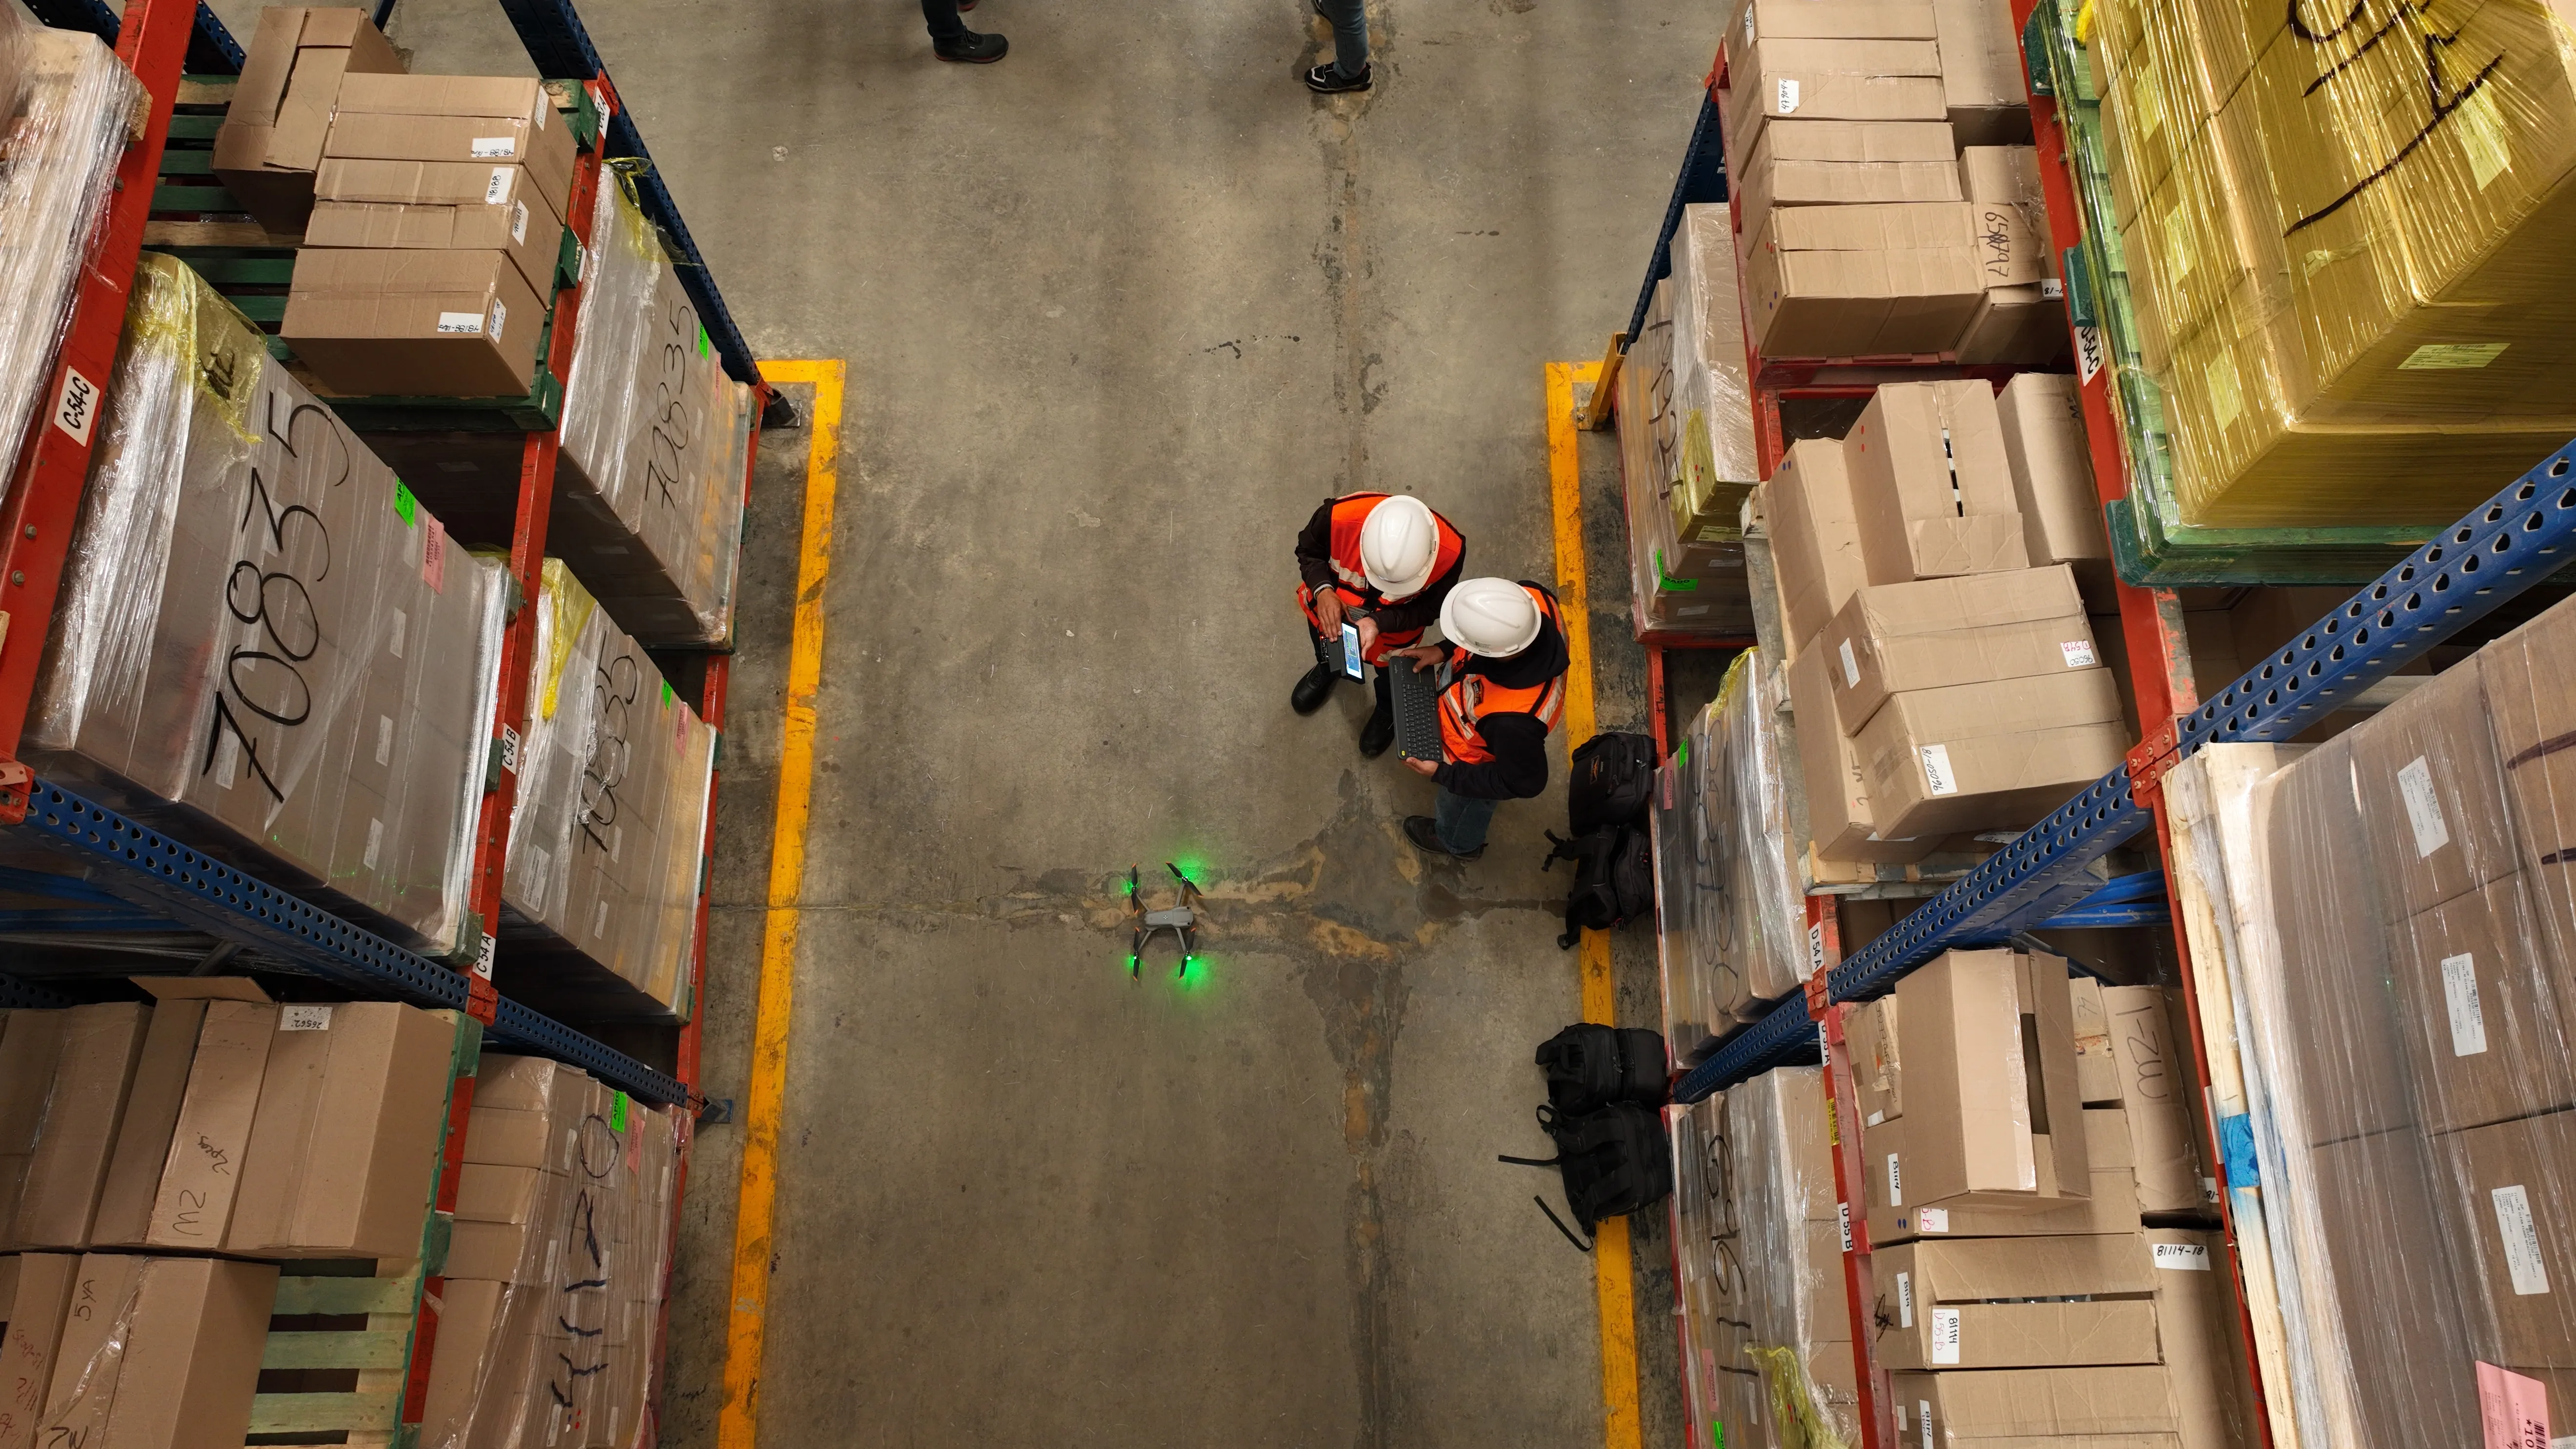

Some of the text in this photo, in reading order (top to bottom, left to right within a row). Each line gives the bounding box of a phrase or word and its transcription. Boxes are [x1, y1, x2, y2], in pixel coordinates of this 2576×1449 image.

[68, 377, 90, 429] C-54-C
[644, 299, 694, 510] 70835
[203, 391, 349, 803] 70835
[2070, 654, 2093, 665] 96050
[503, 729, 516, 766] C 54 B
[1922, 747, 1944, 791] 96050-18
[477, 962, 487, 973] C
[1811, 929, 1822, 969] D 54 A
[294, 1019, 322, 1029] 26562
[172, 1189, 206, 1236] M2
[2157, 1246, 2204, 1256] 81114-18
[74, 1303, 92, 1320] 5
[1949, 1317, 1957, 1344] 81114
